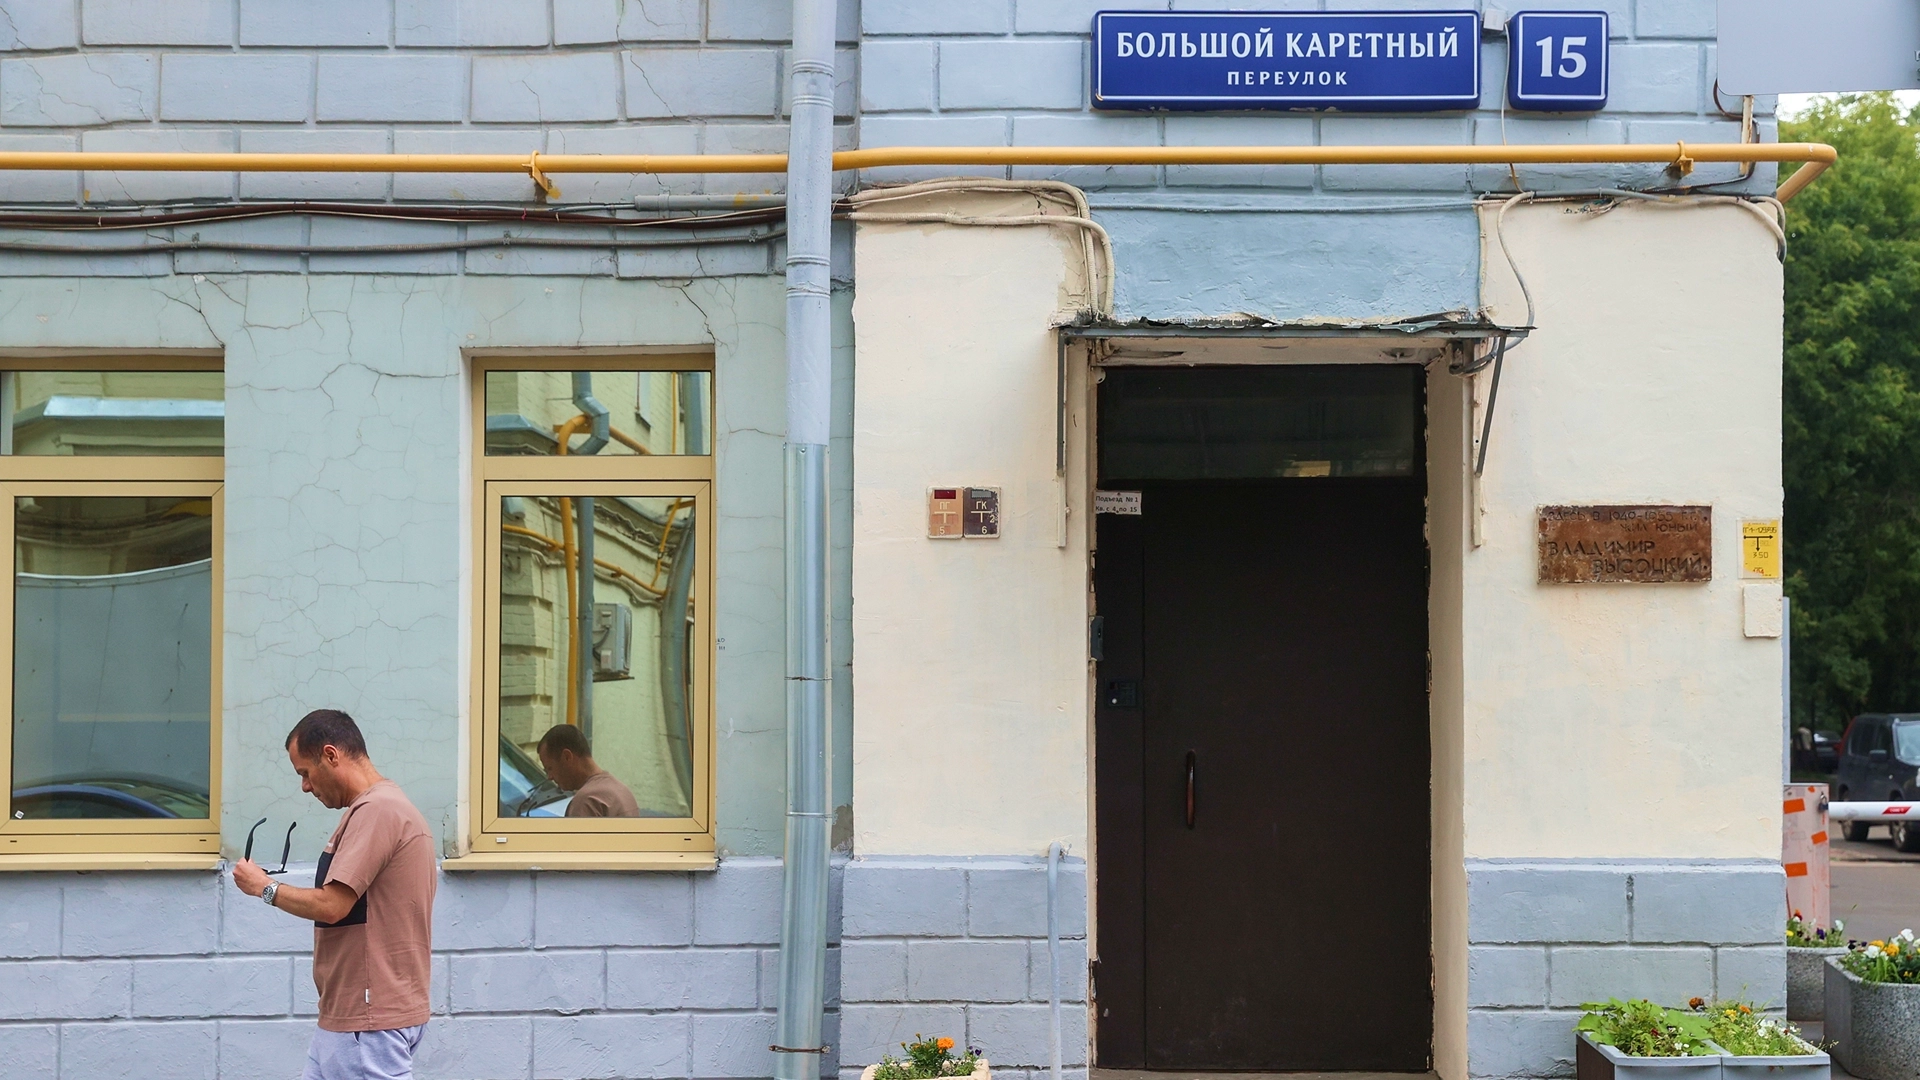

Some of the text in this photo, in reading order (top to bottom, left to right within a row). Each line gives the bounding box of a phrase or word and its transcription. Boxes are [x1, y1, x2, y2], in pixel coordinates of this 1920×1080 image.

[1117, 26, 1459, 58] БОЛЬШОЙ КАРЕТНЫЙ
[1535, 36, 1587, 79] 15
[1227, 71, 1348, 85] ПЕРЕУЛОК
[976, 501, 987, 509] ГК
[989, 514, 995, 523] 2
[1593, 510, 1600, 521] В
[940, 526, 945, 534] 5
[982, 526, 987, 534] 6
[1548, 540, 1656, 556] ВЛАДИМИР
[1593, 552, 1701, 575] ВЫСОЦКИЙ
